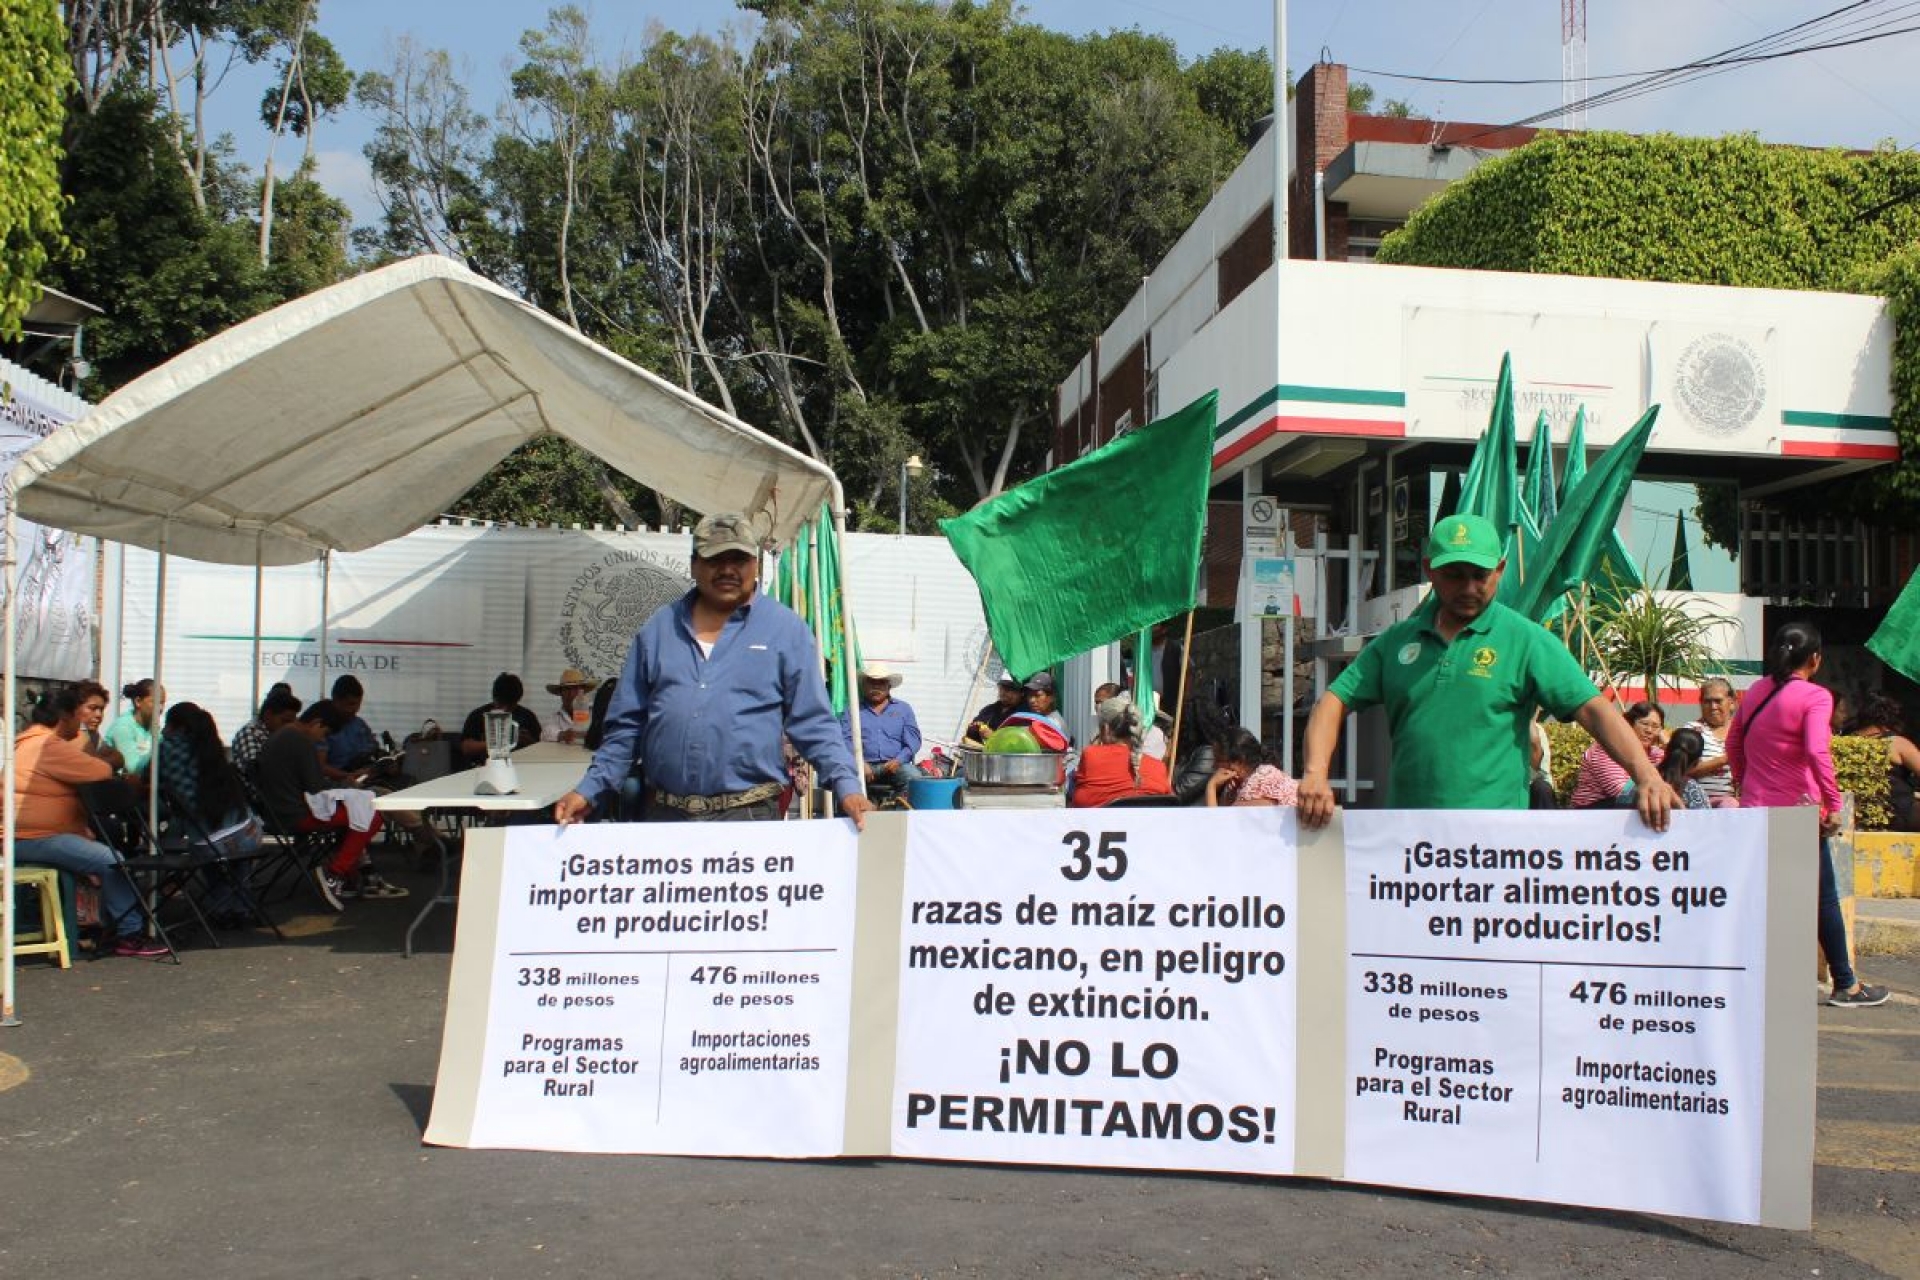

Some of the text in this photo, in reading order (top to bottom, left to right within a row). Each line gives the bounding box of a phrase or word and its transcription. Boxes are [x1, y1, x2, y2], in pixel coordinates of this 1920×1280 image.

[1545, 408, 1598, 424] SOCAL
[562, 549, 659, 617] ESTADOS UNIDOS
[253, 651, 400, 670] ECRETARÍA DE
[560, 850, 794, 883] ¡Gastamos más en
[1060, 830, 1129, 882] 35
[1404, 841, 1689, 874] ¡Gastamos más en
[529, 881, 825, 911] importar alimentos que
[1370, 874, 1727, 915] importar alimentos que
[576, 908, 769, 939] en producirlos!
[911, 893, 1286, 929] razas de maíz criollo
[1428, 911, 1661, 945] en producirlos!
[690, 965, 820, 985] 476 millones
[909, 938, 1286, 984] mexicano, en peligro
[517, 967, 639, 987] 338 millones
[1364, 970, 1508, 1000] 338 millones
[537, 993, 615, 1010] de pesos
[712, 992, 794, 1009] de pesos
[973, 983, 1209, 1021] de extinción.
[1569, 980, 1726, 1009] 476 millones
[1388, 1002, 1480, 1023] de pesos
[1599, 1013, 1697, 1035] de pesos
[522, 1033, 623, 1057] Programas
[692, 1029, 811, 1052] Importaciones
[503, 1055, 639, 1078] para el Sector
[679, 1052, 820, 1076] agroalimentarias
[999, 1039, 1179, 1084] ¡NO LO
[1375, 1047, 1494, 1076] Programas
[1575, 1055, 1717, 1086] Importaciones
[543, 1079, 594, 1097] Rural
[1356, 1076, 1513, 1103] para el Sector
[1562, 1079, 1729, 1115] agroalimentarias
[906, 1093, 1276, 1145] PERMITAMOS!
[1404, 1100, 1461, 1125] Rural
